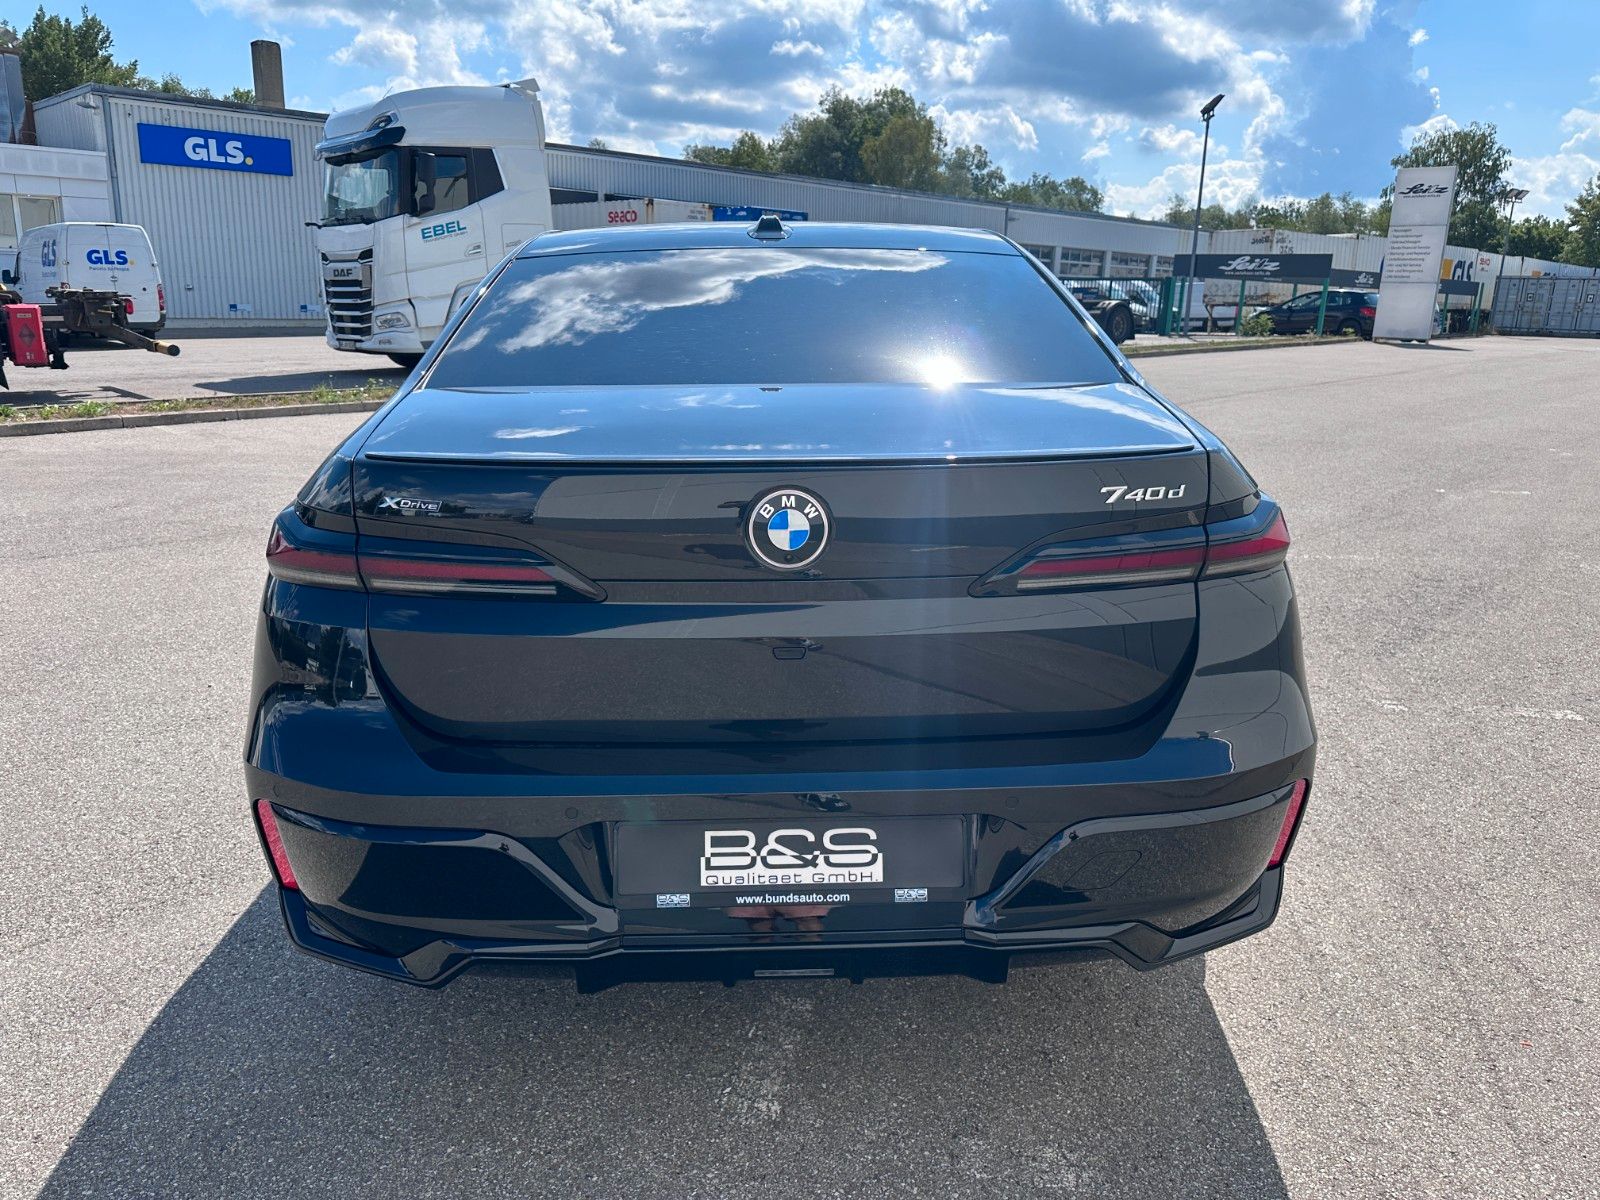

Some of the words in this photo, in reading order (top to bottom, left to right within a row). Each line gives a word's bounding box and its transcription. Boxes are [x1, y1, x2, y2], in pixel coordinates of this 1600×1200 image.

[607, 209, 638, 224] seaco
[421, 220, 467, 240] EBEL
[333, 268, 353, 278] DAF
[1100, 484, 1186, 504] 740d
[759, 495, 820, 519] BMW
[704, 827, 879, 871] B&S
[705, 872, 802, 886] Qualitaet
[735, 892, 850, 904] www.bundsauto.com
